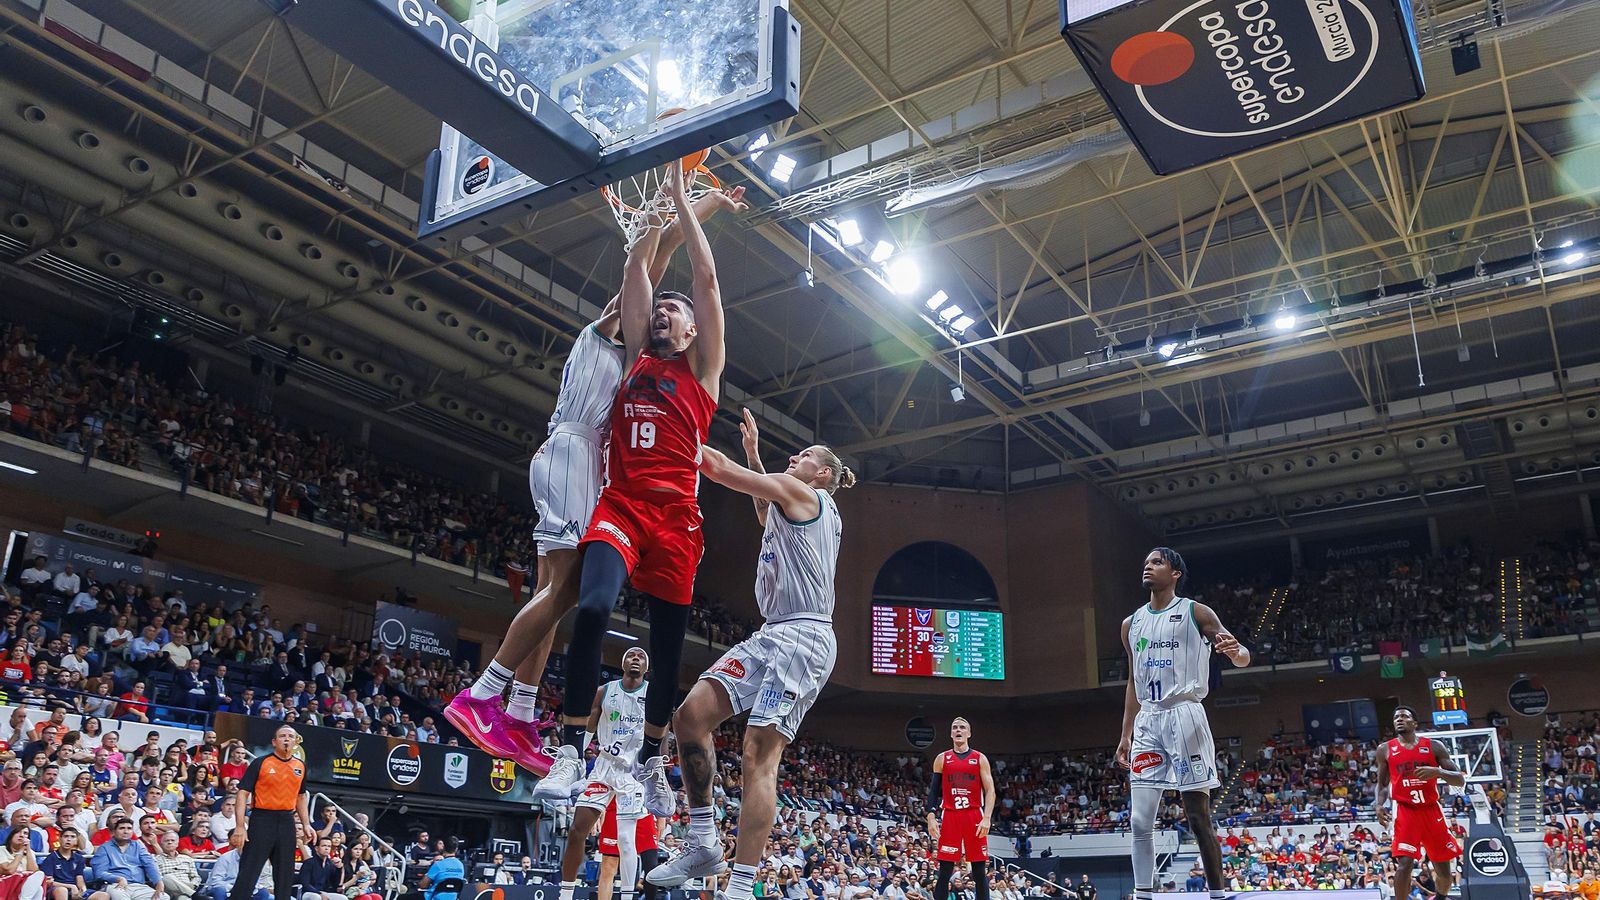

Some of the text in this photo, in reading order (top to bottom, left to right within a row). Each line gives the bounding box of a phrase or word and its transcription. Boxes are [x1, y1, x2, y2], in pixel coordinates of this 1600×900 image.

[1314, 0, 1351, 57] Murcia '2
[398, 0, 540, 116] endesa
[1235, 0, 1304, 103] endesa
[1198, 11, 1270, 124] supercopa
[630, 421, 656, 449] 19
[75, 523, 115, 540] Grada
[73, 553, 107, 566] endesa
[917, 631, 930, 642] 30
[948, 633, 959, 643] 31
[409, 642, 451, 657] DE MURCIA
[927, 644, 950, 653] 3:22
[1148, 680, 1161, 701] 11
[1432, 680, 1455, 689] LOTUS
[619, 714, 644, 724] Unicaja
[333, 758, 362, 770] UCAM
[392, 764, 418, 773] endesa
[954, 796, 970, 810] 22
[1410, 790, 1426, 804] 31
